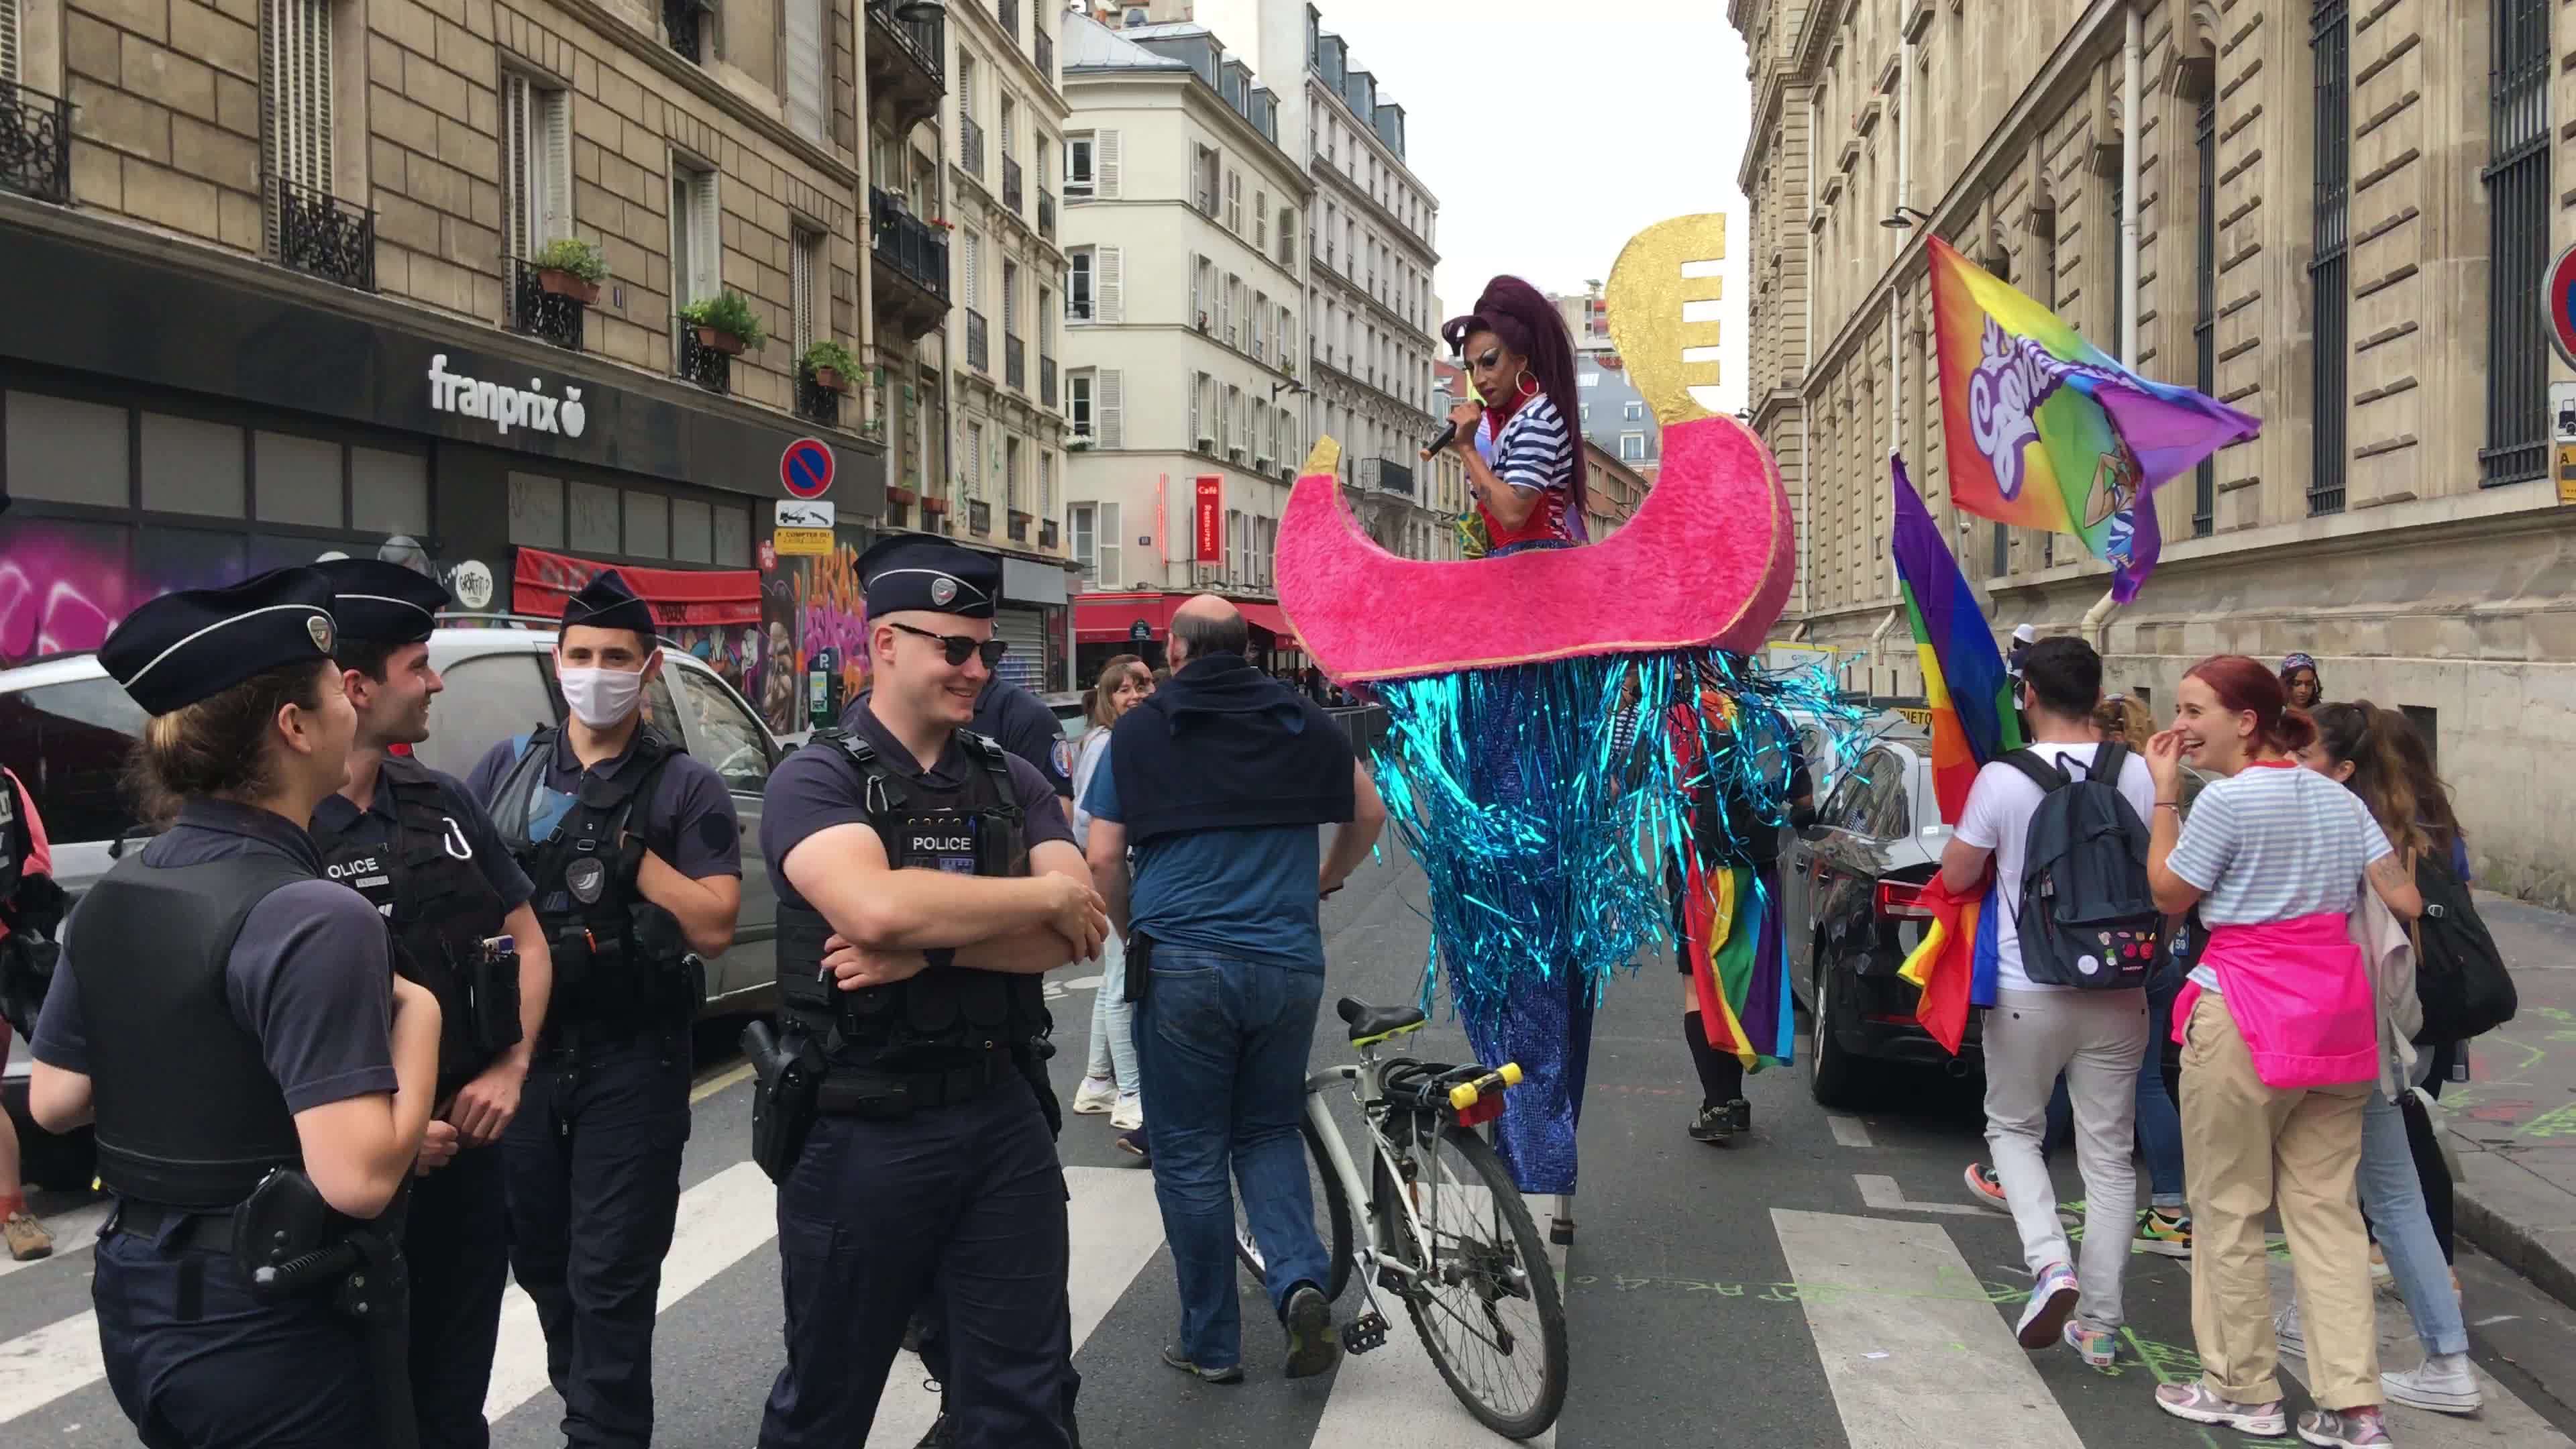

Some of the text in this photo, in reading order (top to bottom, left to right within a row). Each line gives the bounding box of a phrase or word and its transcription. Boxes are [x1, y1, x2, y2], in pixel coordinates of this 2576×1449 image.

[428, 354, 559, 434] franprix
[1197, 486, 1218, 494] Café
[1203, 504, 1213, 552] Restaurant
[912, 837, 971, 850] POLICE
[327, 857, 379, 878] OLICE
